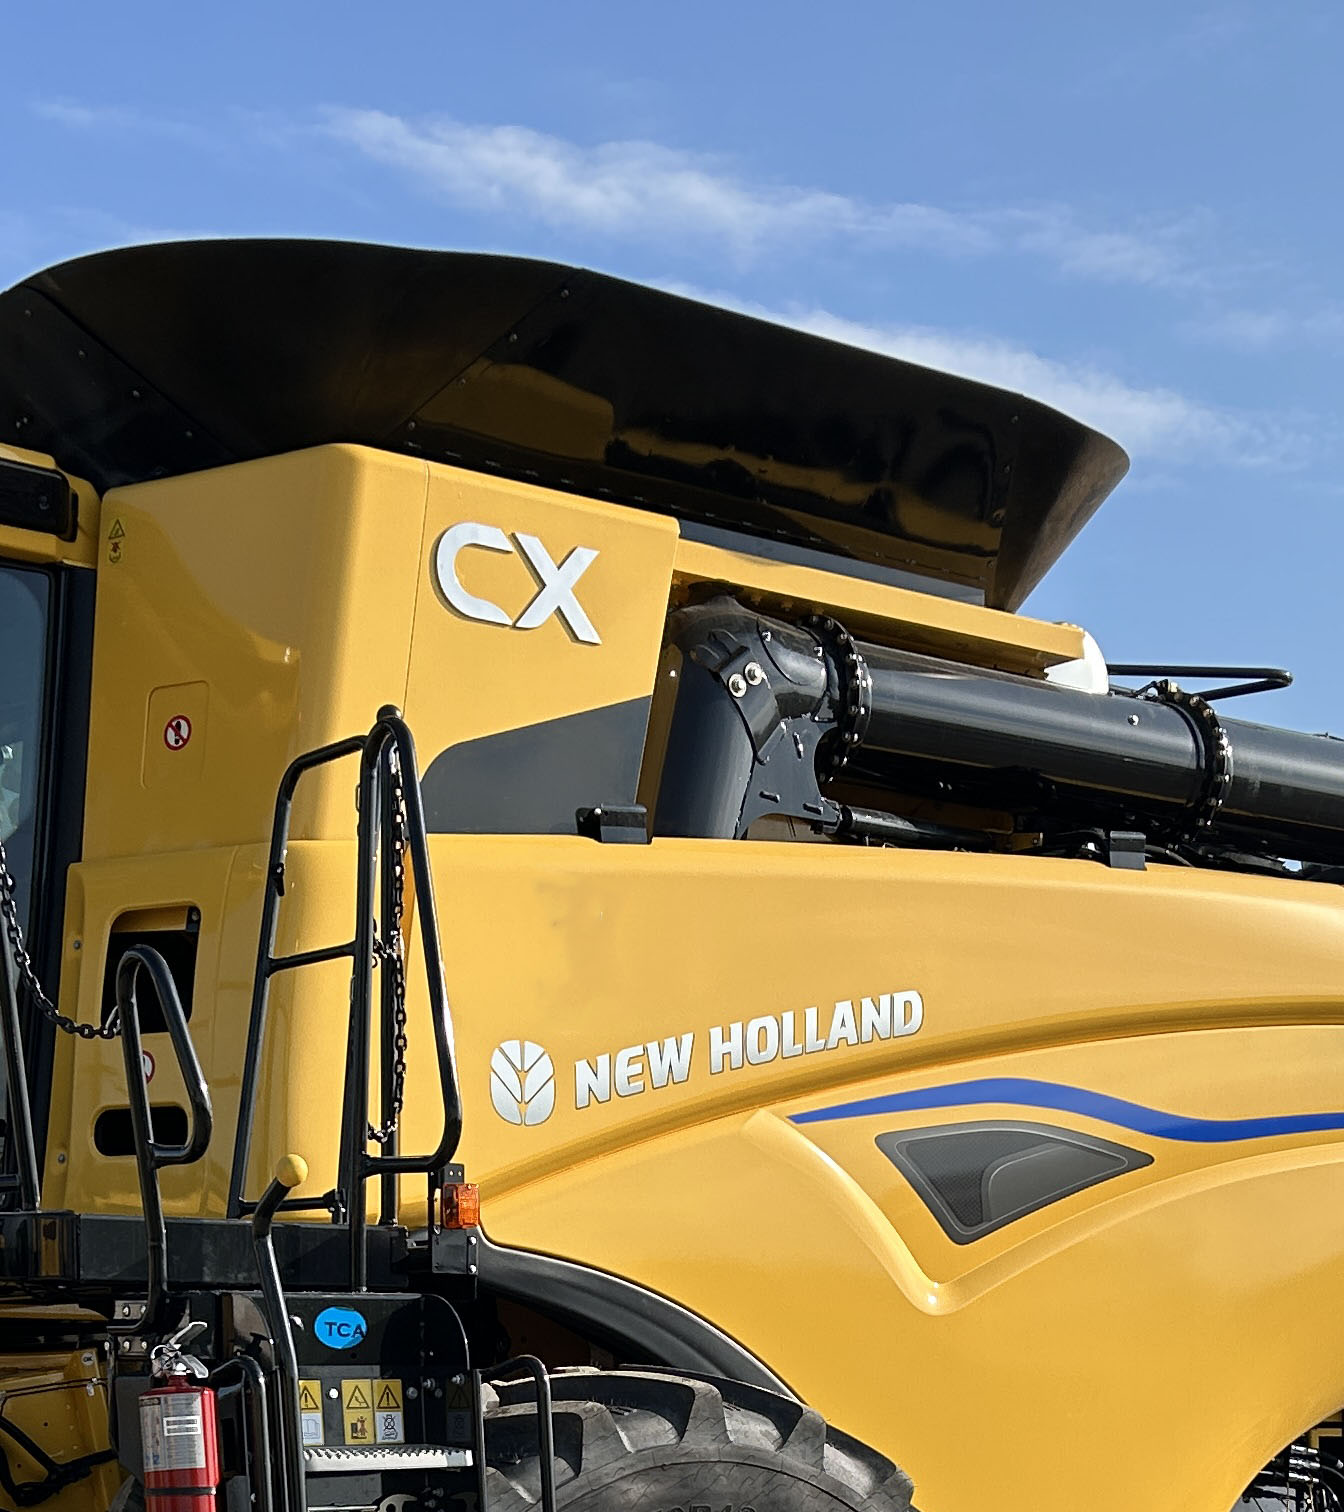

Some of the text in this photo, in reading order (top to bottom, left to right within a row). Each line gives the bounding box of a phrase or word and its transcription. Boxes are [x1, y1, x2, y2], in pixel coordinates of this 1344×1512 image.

[430, 522, 602, 646] CX
[574, 989, 924, 1110] NEW HOLLAND
[323, 1321, 364, 1339] TCA
